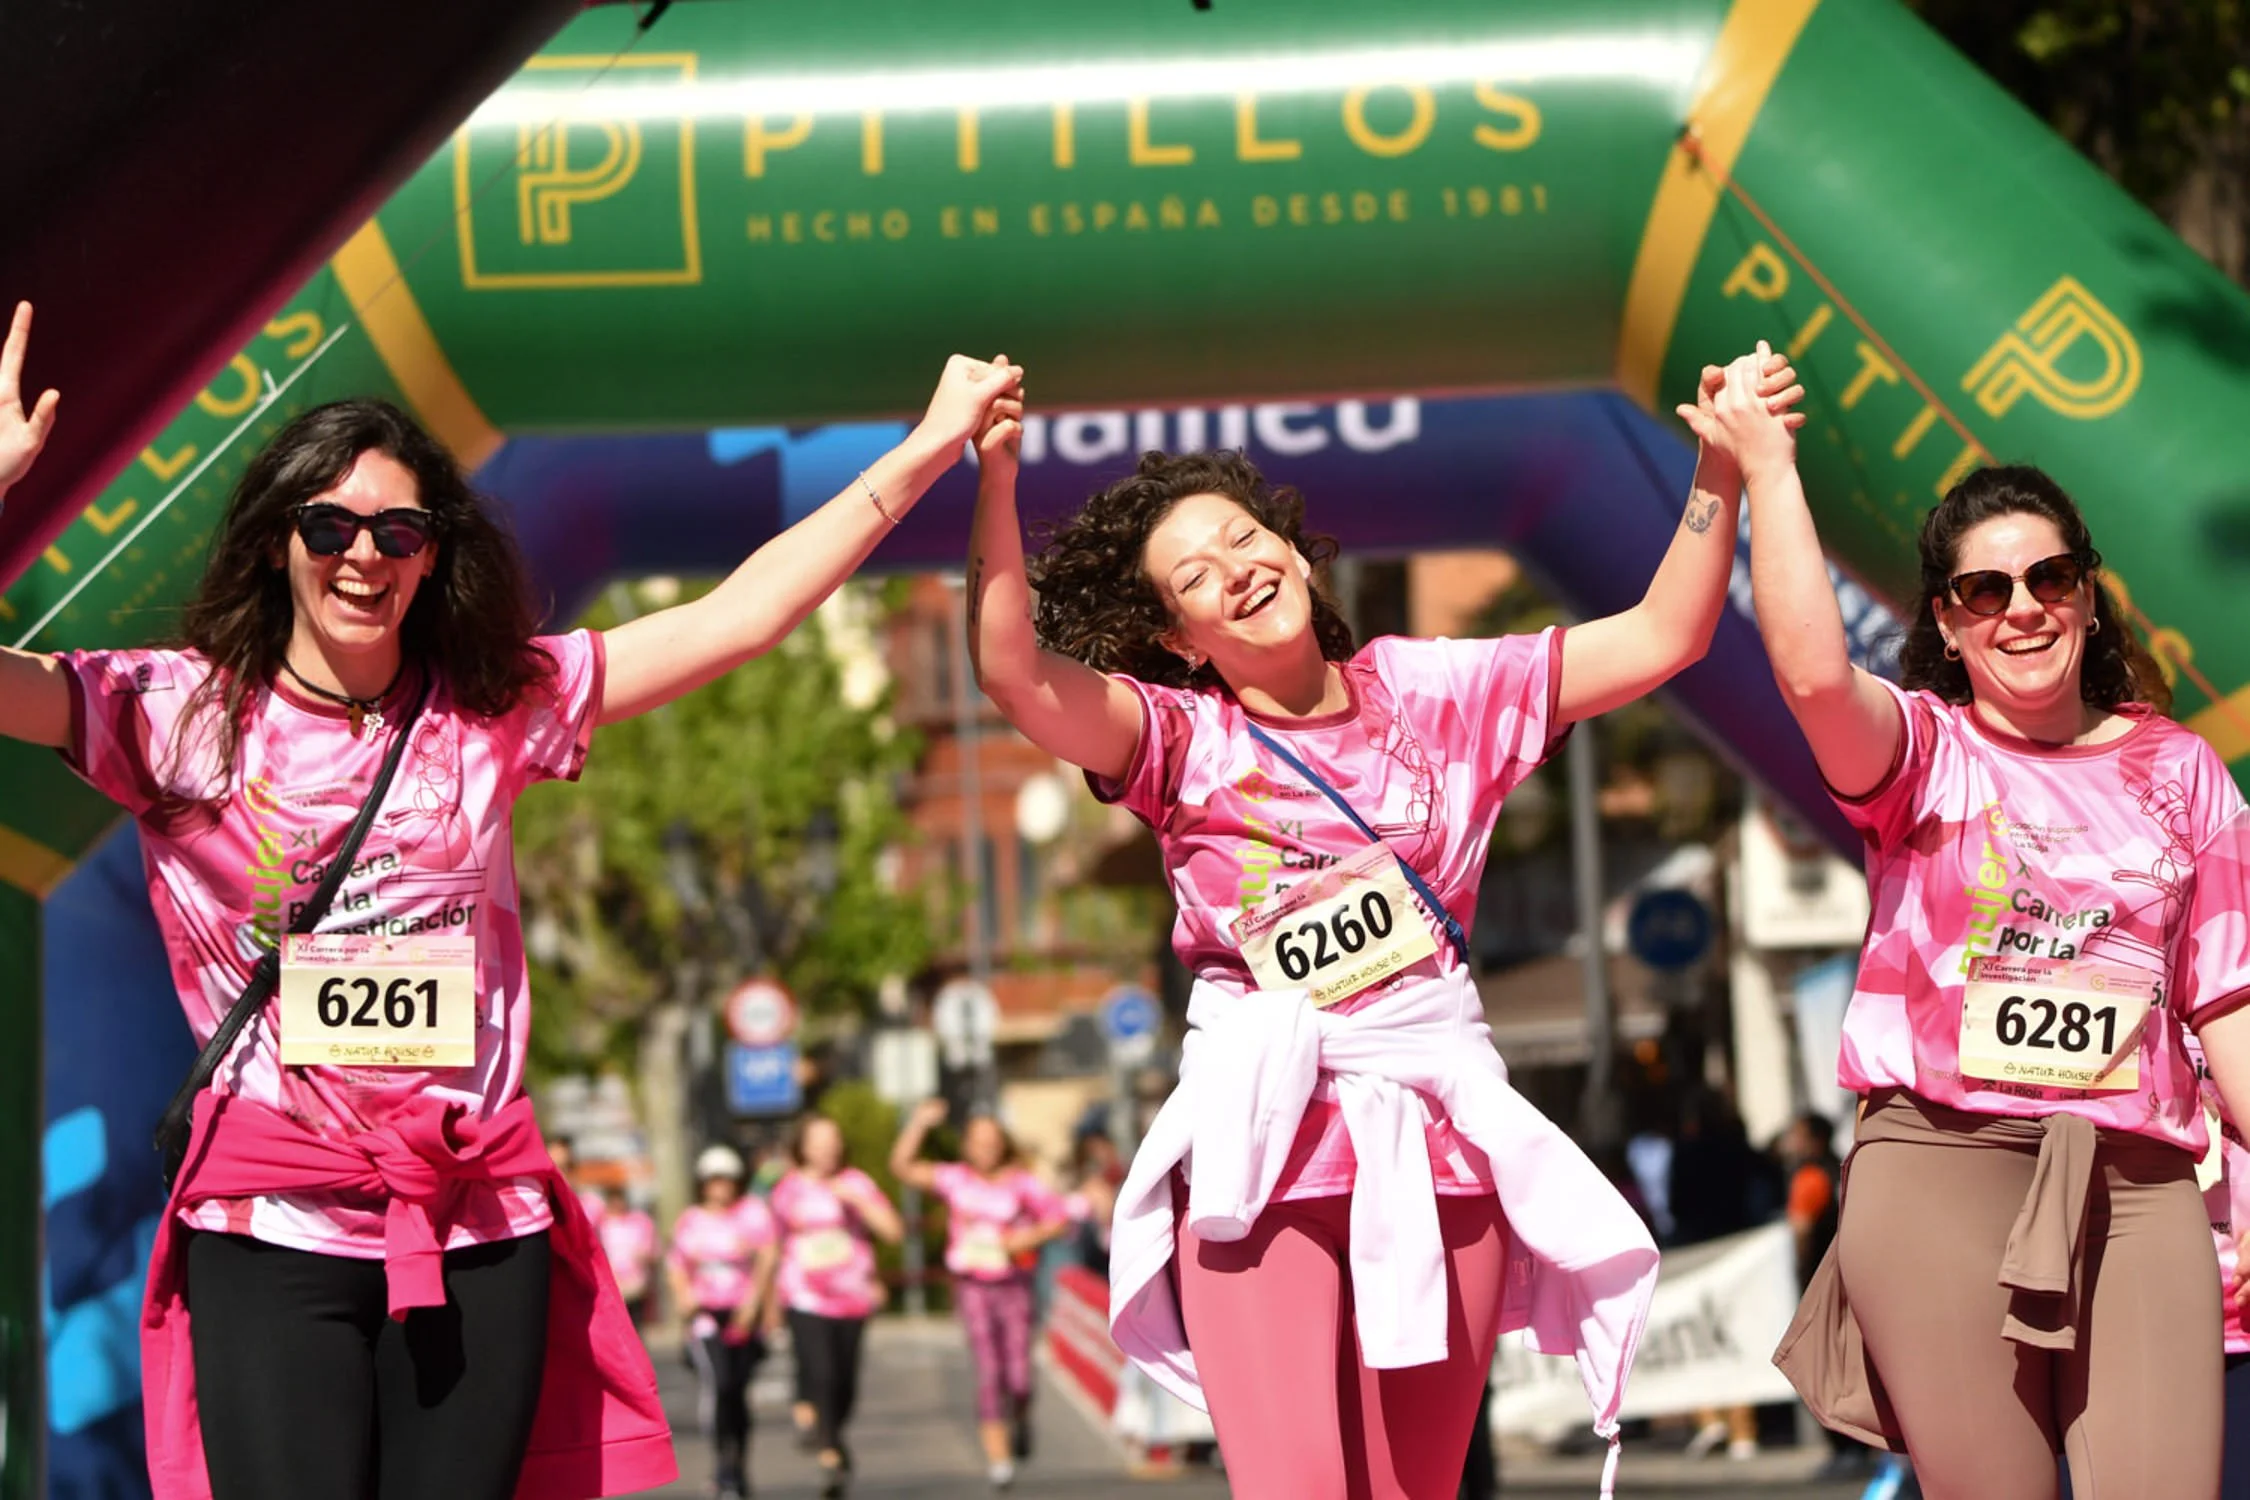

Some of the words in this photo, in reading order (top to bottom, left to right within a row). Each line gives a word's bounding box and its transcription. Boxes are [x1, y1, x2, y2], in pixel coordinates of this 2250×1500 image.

[746, 208, 911, 243] HECHO
[940, 206, 999, 238] EN
[1029, 194, 1222, 237] ESPAÑA
[1251, 189, 1410, 227] DESDE
[1442, 184, 1548, 217] 1981
[288, 827, 320, 850] XI
[290, 850, 397, 885] Caera
[1280, 845, 1344, 870] Carr
[343, 888, 372, 912] la
[2011, 887, 2110, 931] Carrera
[1275, 890, 1393, 981] 6260
[1996, 926, 2045, 954] por
[2048, 937, 2077, 960] la
[317, 977, 439, 1029] 6261
[1995, 995, 2117, 1056] 6281
[1999, 1083, 2012, 1094] La
[2018, 1066, 2056, 1077] NATUR
[2058, 1068, 2094, 1082] HOUSE
